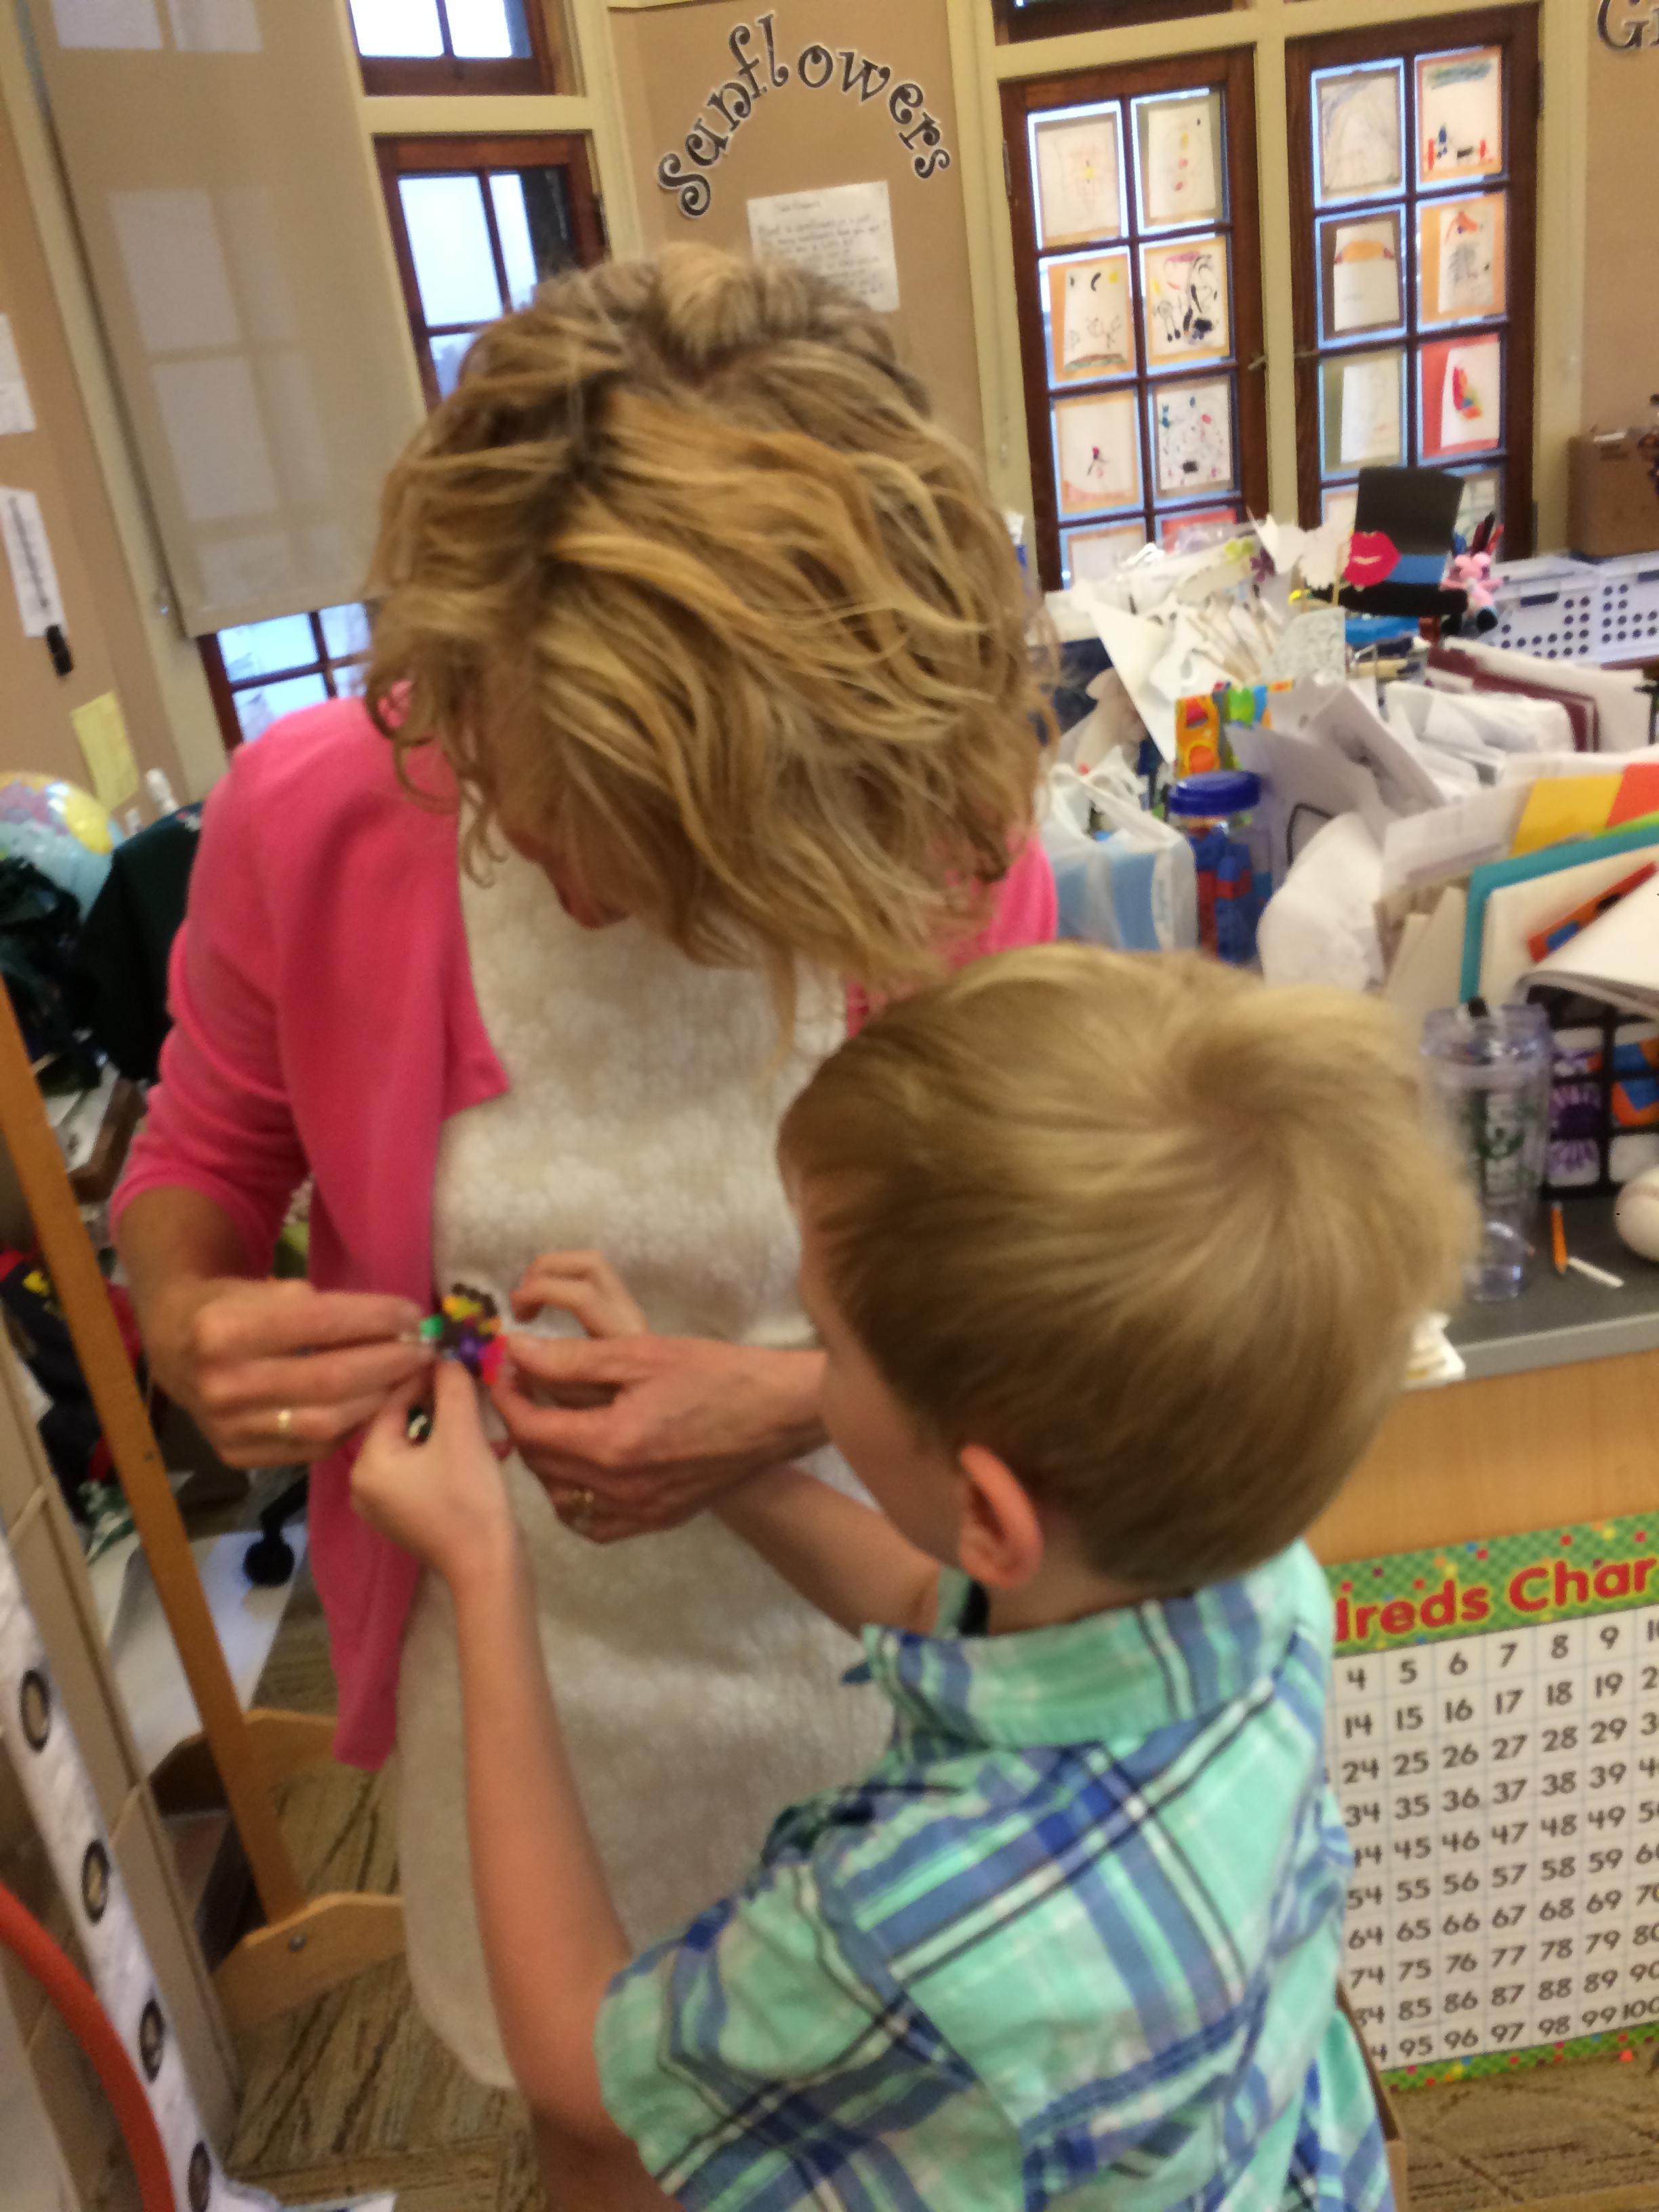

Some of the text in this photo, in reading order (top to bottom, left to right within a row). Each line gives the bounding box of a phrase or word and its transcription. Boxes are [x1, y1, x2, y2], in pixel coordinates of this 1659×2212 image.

[658, 12, 950, 217] Sunflowers
[1347, 1620, 1659, 1690] 4 5 6 7 8 9 1
[1345, 1713, 1372, 1738] 14
[1397, 1706, 1423, 1730] 15
[1445, 1698, 1474, 1723] 16
[1496, 1689, 1524, 1714] 17
[1547, 1681, 1572, 1706] 18
[1595, 1672, 1623, 1698] 19
[1343, 1757, 1379, 1784] 24
[1394, 1750, 1429, 1776] 25
[1443, 1742, 1479, 1769] 26
[1492, 1734, 1528, 1760] 27
[1542, 1725, 1578, 1752] 28
[1591, 1718, 1627, 1744] 29
[1345, 1757, 1659, 1827] 34 35 36 37 38 39 4
[1394, 1836, 1431, 1860] 45
[1442, 1830, 1479, 1852] 46
[1492, 1821, 1528, 1845] 47
[1541, 1814, 1578, 1837] 48
[1588, 1805, 1626, 1830] 49
[1639, 1801, 1659, 1823] 5
[1348, 1843, 1659, 1910] 54 55 56 57 58 59 6
[1349, 1925, 1383, 1950] 64
[1397, 1918, 1431, 1942] 65
[1443, 1912, 1480, 1936] 66
[1492, 1904, 1527, 1928] 67
[1540, 1898, 1574, 1921] 68
[1586, 1889, 1622, 1914] 69
[1351, 1966, 1385, 1989] 74
[1399, 1959, 1431, 1982] 75
[1446, 1952, 1478, 1973] 76
[1492, 1945, 1527, 1968] 77
[1540, 1938, 1572, 1961] 78
[1586, 1930, 1621, 1954] 79
[1398, 1997, 1432, 2022] 85
[1444, 1991, 1478, 2013] 86
[1492, 1984, 1525, 2007] 87
[1538, 1978, 1572, 2001] 88
[1584, 1969, 1618, 1993] 89
[1399, 2036, 1433, 2057] 95
[1444, 2028, 1479, 2050] 96
[1491, 2022, 1524, 2043] 97
[1538, 2015, 1571, 2037] 98
[1582, 2006, 1617, 2028] 99
